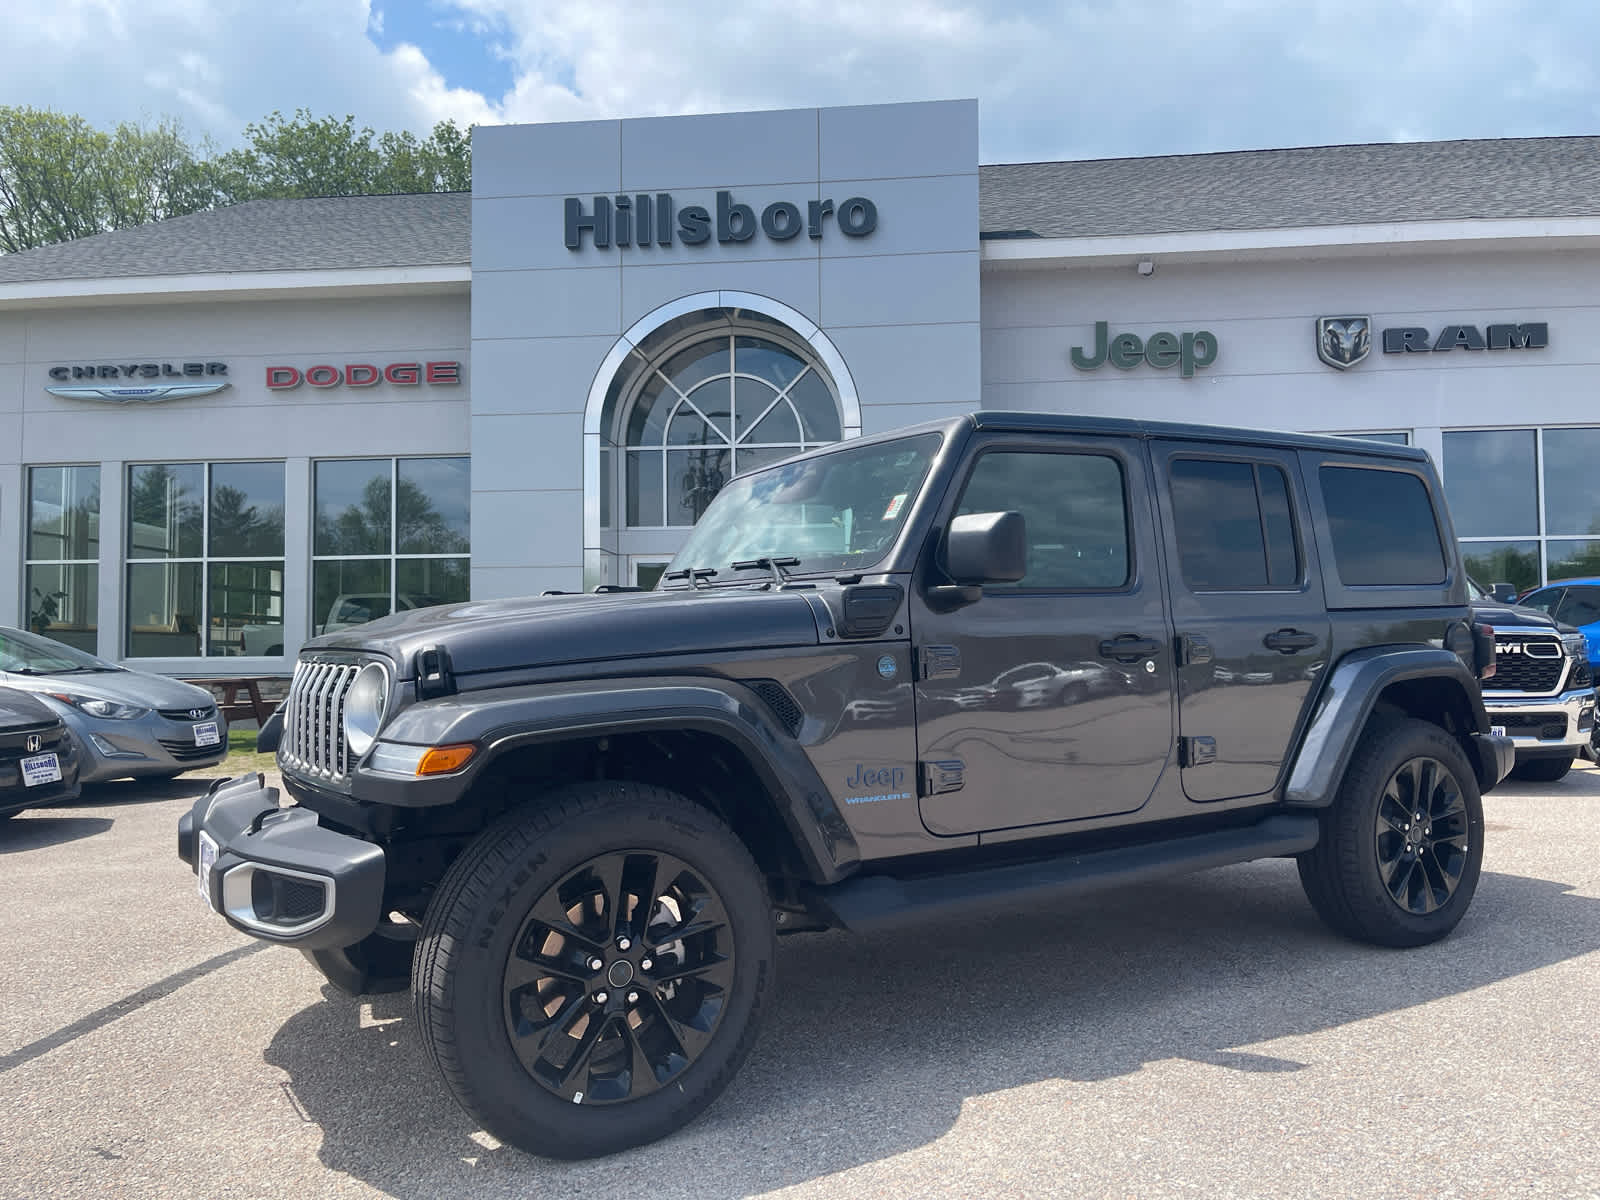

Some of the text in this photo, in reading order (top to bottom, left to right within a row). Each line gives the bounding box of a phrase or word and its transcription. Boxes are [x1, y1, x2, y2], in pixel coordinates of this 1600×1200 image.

[564, 190, 878, 250] Hillsboro
[1070, 320, 1218, 378] Jeep
[1383, 322, 1549, 353] RAM
[49, 362, 228, 380] CHRYSLER
[265, 361, 461, 391] DODGE
[24, 757, 57, 772] HILLSBORO
[847, 763, 905, 790] Jeep
